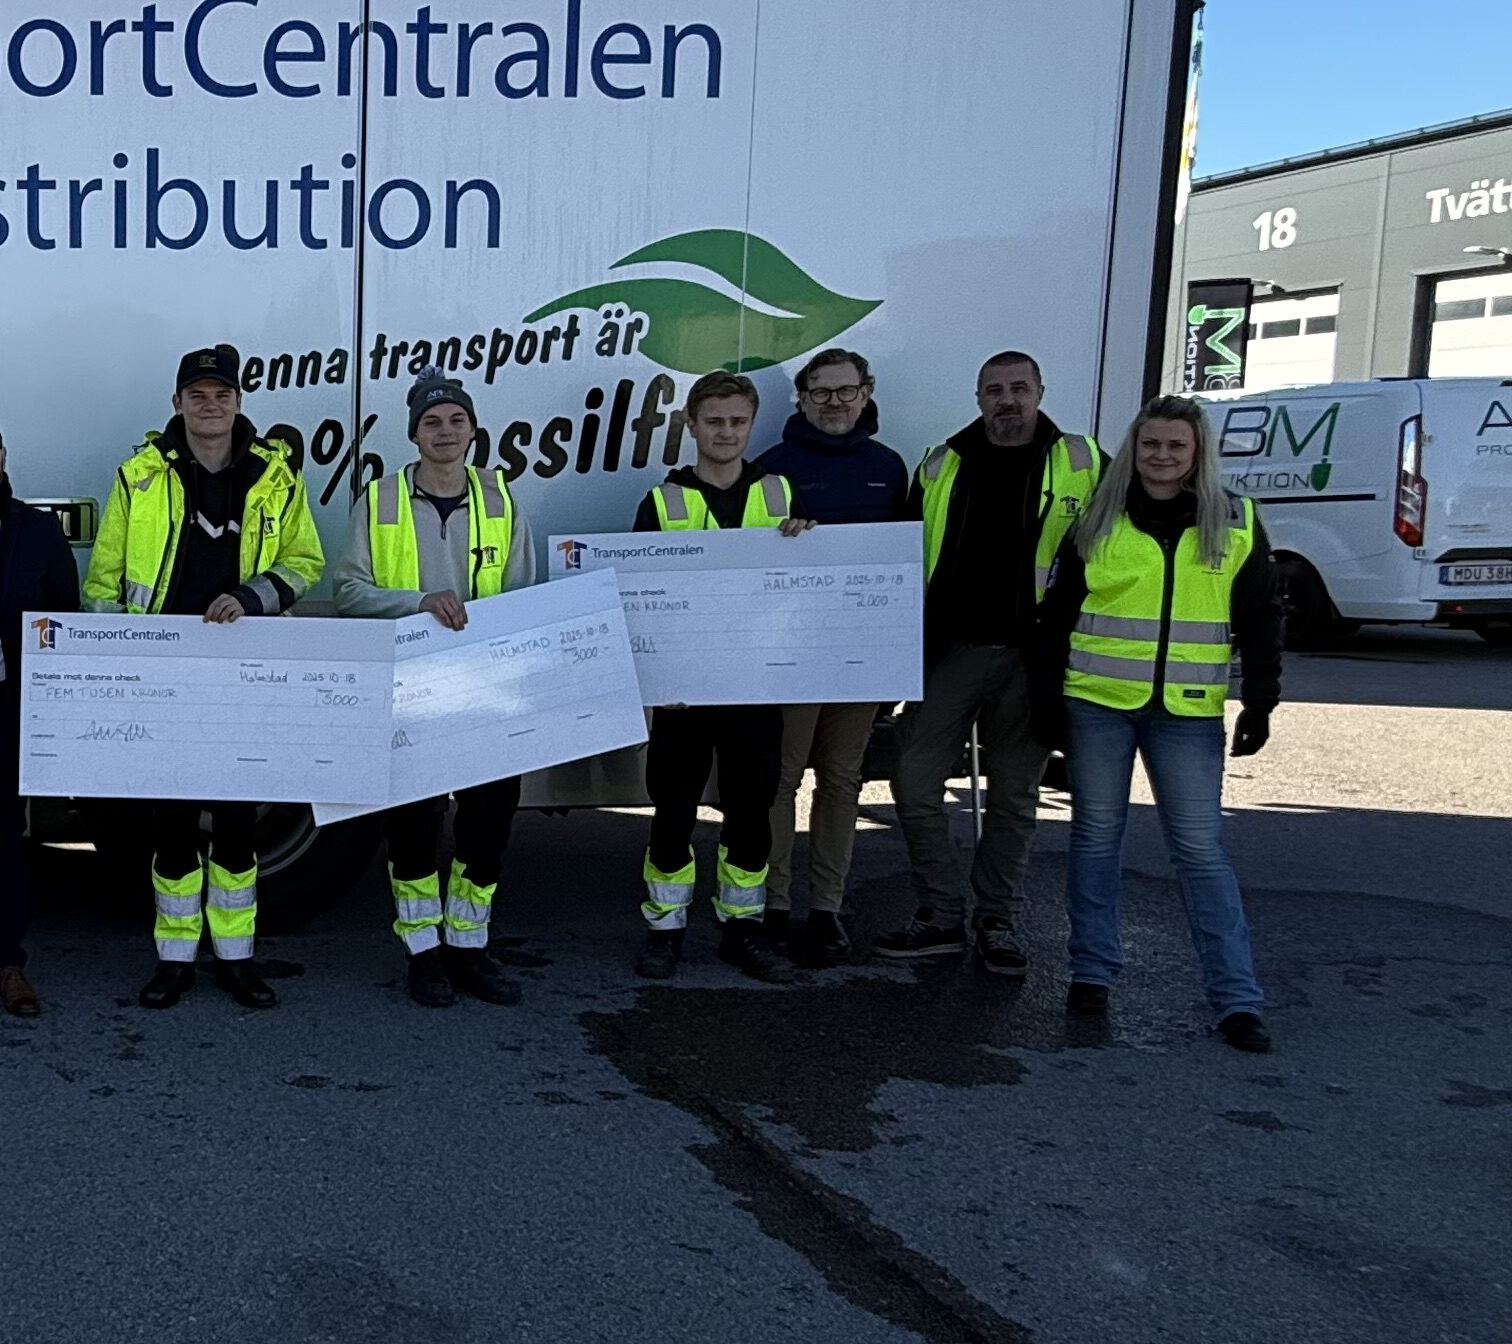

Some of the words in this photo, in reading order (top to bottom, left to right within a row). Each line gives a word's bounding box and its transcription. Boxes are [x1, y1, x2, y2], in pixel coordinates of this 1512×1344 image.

[1252, 207, 1297, 251] 18
[223, 344, 349, 393] enna
[369, 315, 580, 384] transport
[596, 309, 644, 357] är
[1476, 400, 1512, 437] A
[1219, 402, 1341, 457] BM
[592, 544, 704, 559] TransportCentralen
[763, 575, 834, 591] HALMSTAD
[1454, 568, 1482, 580] MDU
[67, 627, 181, 641] TransportCentralen
[489, 637, 550, 660] HALMSTAD
[46, 687, 73, 699] FEM
